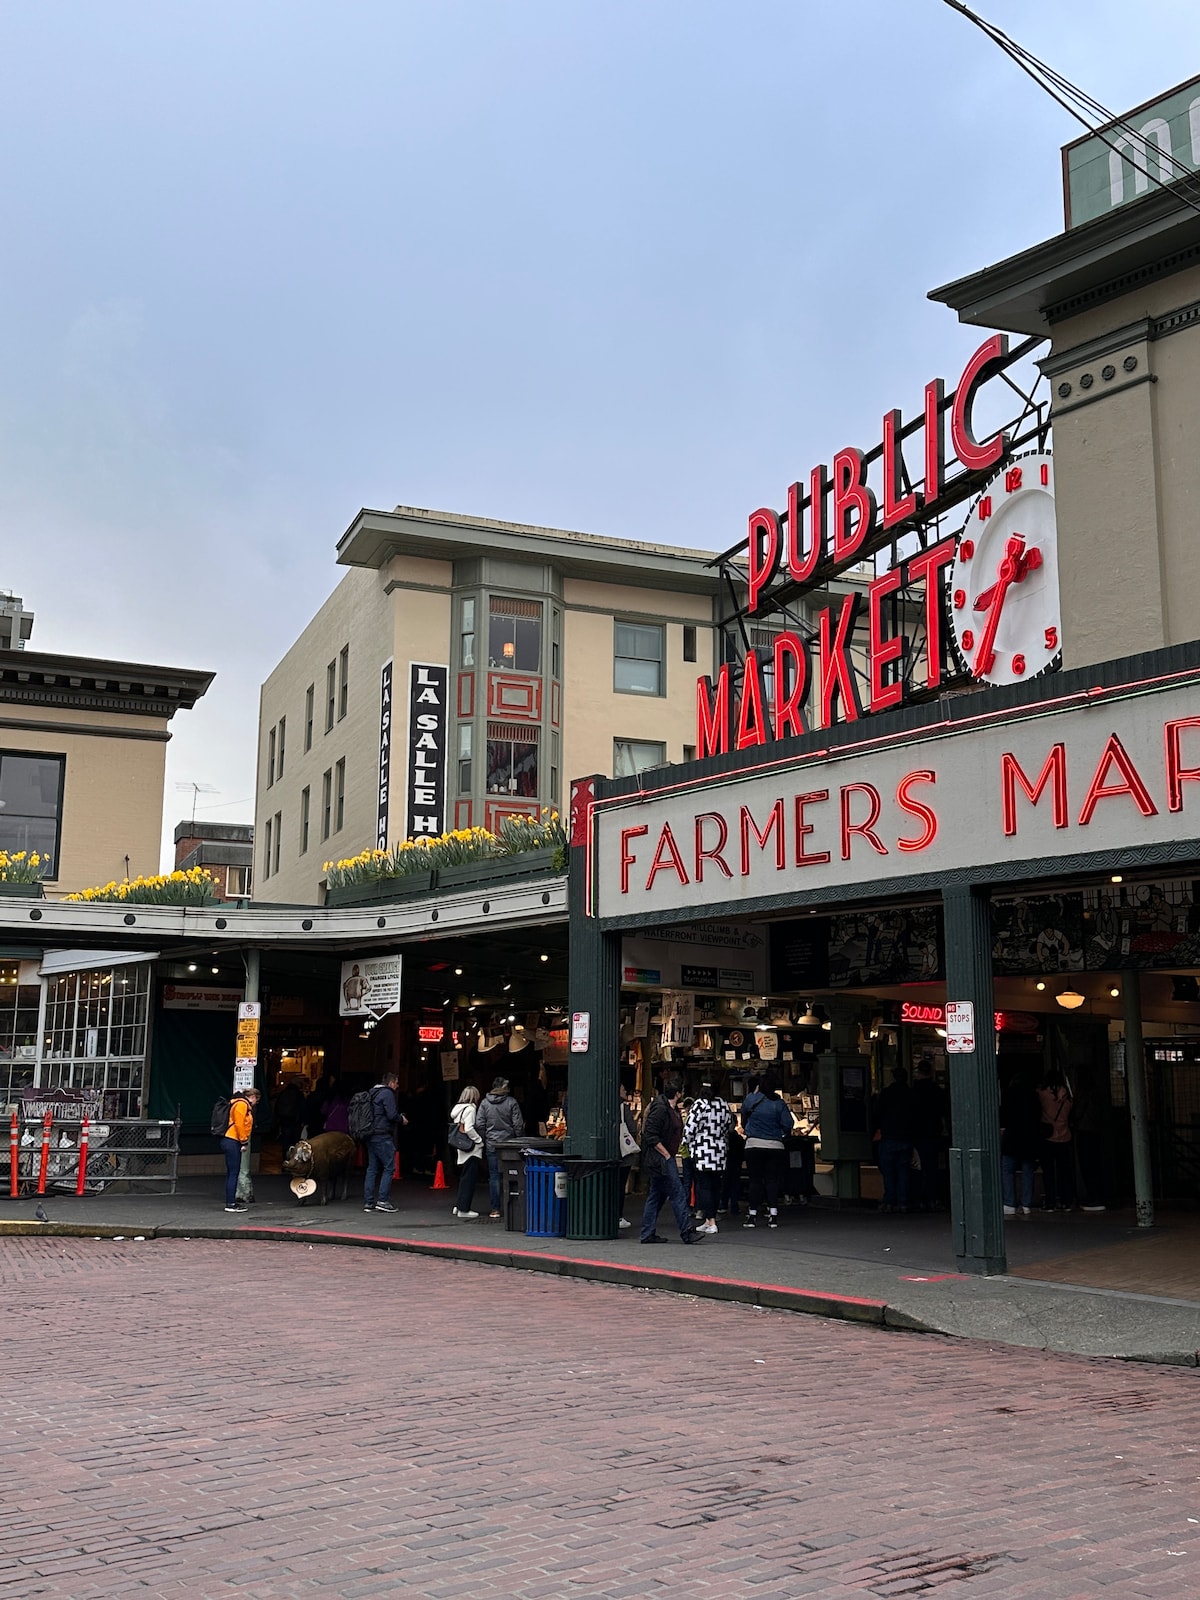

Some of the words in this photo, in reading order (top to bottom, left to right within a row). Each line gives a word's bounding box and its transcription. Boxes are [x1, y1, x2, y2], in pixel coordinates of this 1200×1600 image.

[748, 333, 1009, 613] PUBLIC
[1006, 467, 1022, 492] 12
[1041, 464, 1048, 485] 1
[979, 496, 992, 520] 11
[960, 539, 974, 562] 10
[953, 589, 966, 609] 9
[696, 537, 956, 760] MARKET
[961, 630, 974, 651] 8
[1045, 626, 1057, 650] 5
[1012, 654, 1025, 675] 6
[383, 672, 391, 705] LA
[416, 668, 441, 705] LA
[380, 711, 390, 804] SALLE
[414, 714, 438, 805] SALLE
[620, 769, 938, 894] FARMERS
[644, 927, 697, 941] WATERFRONT
[699, 933, 742, 946] VIEWPOINT
[691, 924, 730, 935] HILLCLIMB
[902, 1002, 943, 1021] SOUND
[948, 1004, 956, 1013] NO
[950, 1014, 970, 1023] STOPS
